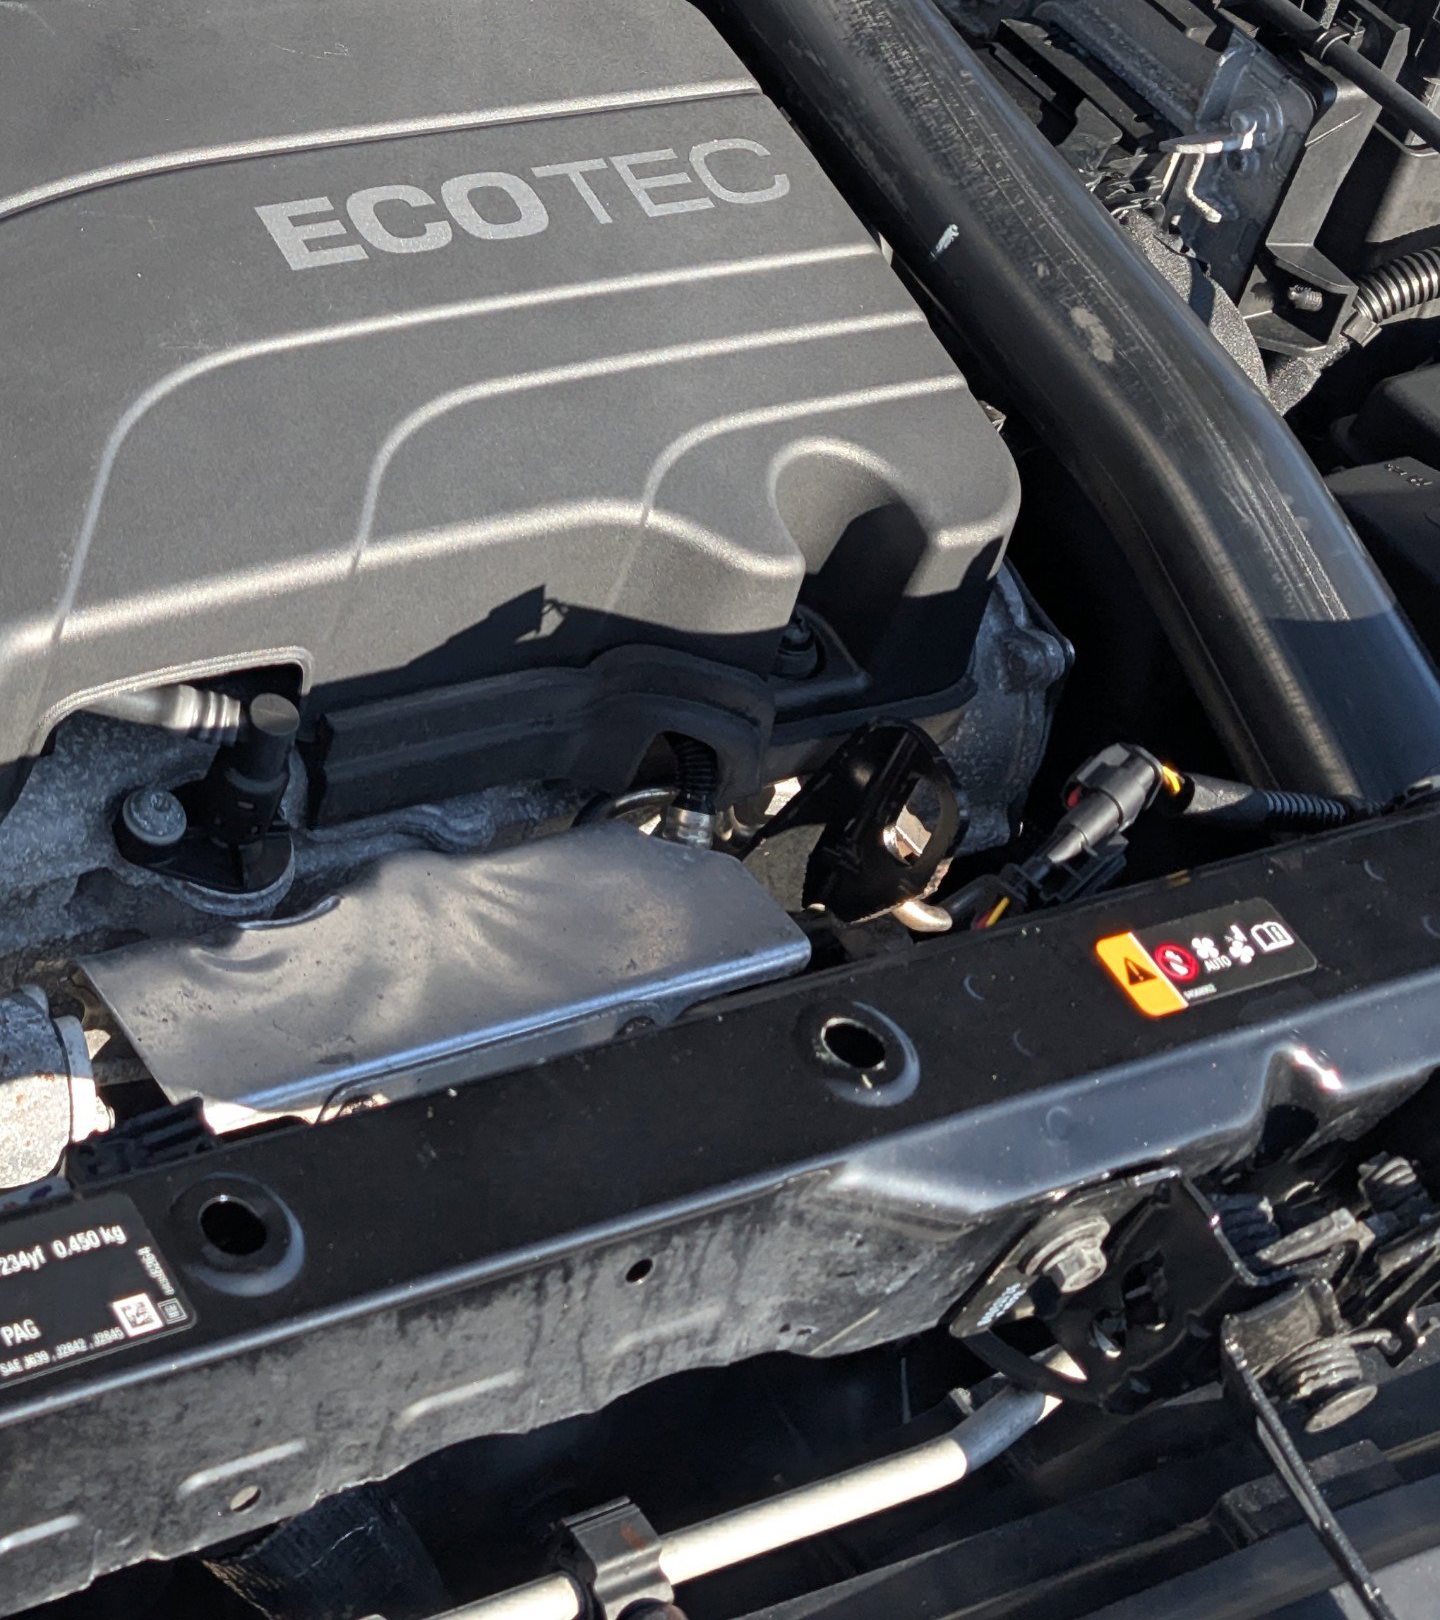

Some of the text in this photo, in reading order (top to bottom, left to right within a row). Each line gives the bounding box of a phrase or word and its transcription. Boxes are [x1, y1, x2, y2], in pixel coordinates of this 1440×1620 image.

[255, 138, 791, 271] ECOTEC
[1203, 955, 1233, 973] AUTO
[51, 1229, 99, 1259] 0.450
[98, 1224, 127, 1246] kg
[0, 1318, 41, 1348] PAG
